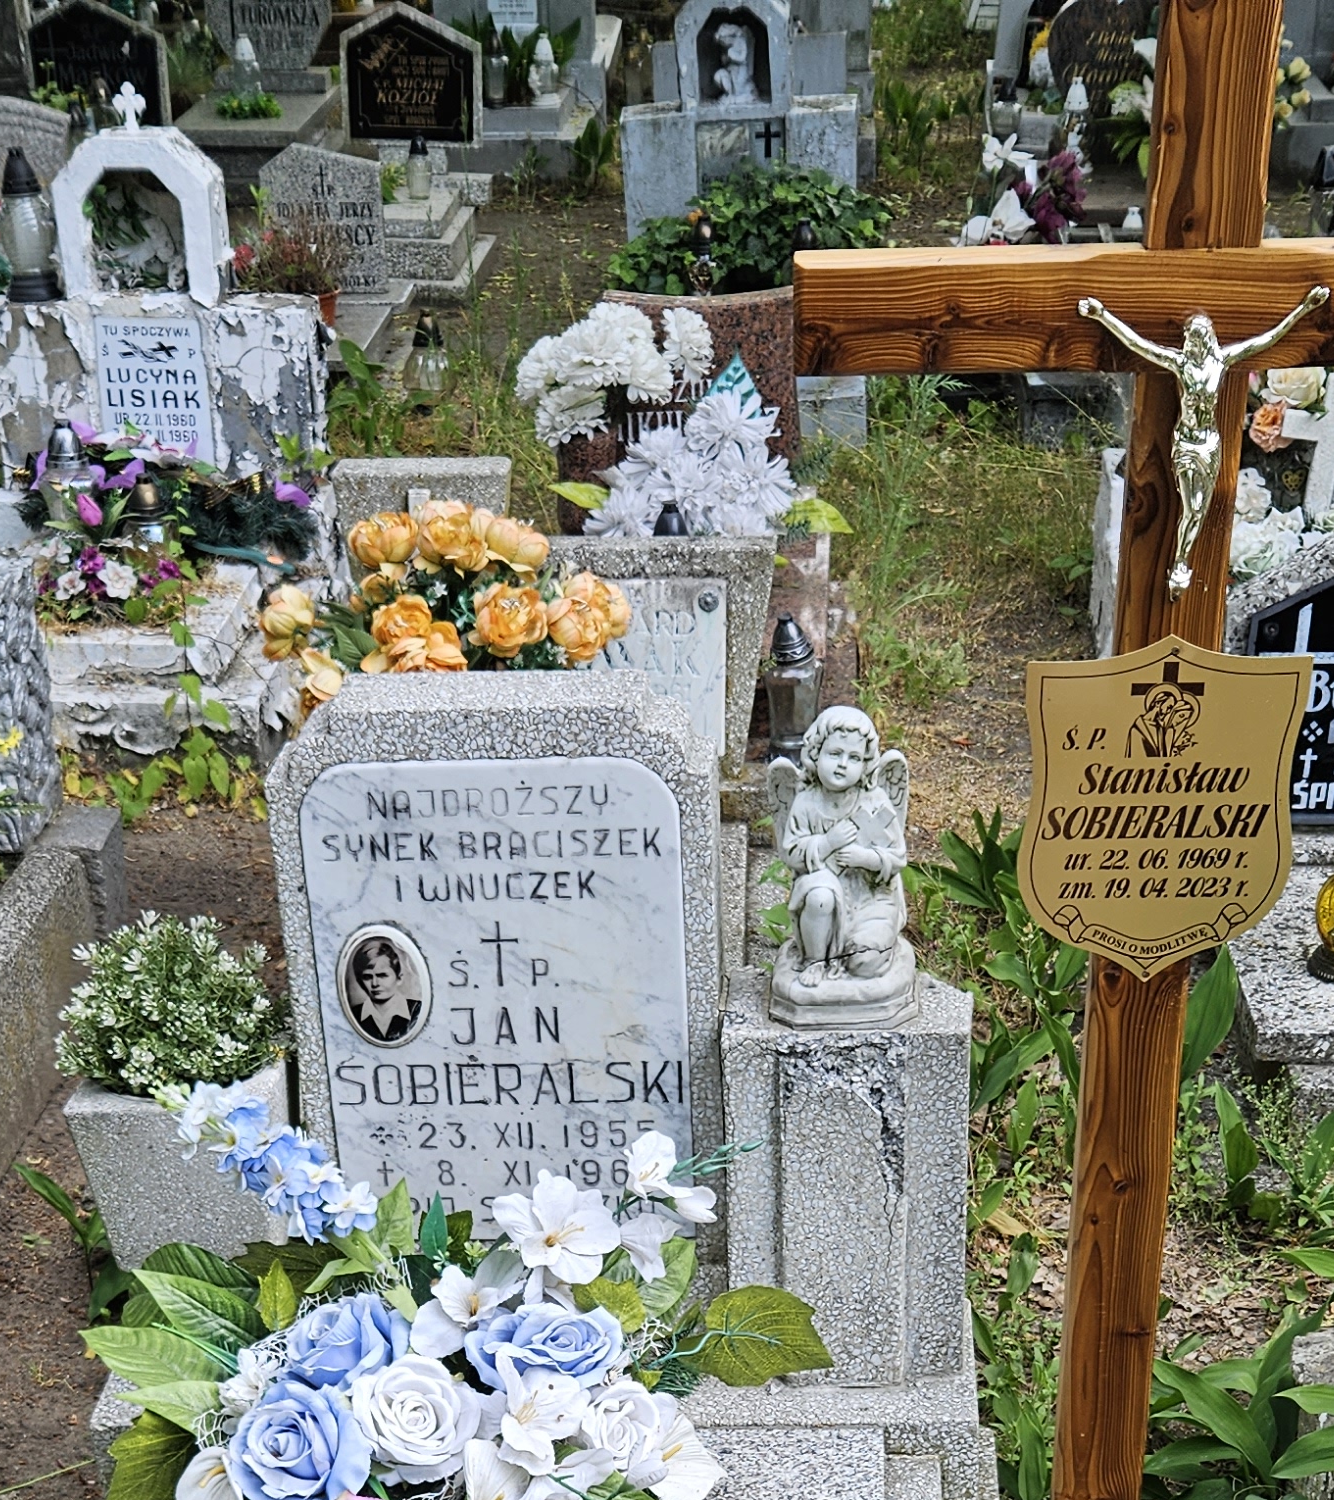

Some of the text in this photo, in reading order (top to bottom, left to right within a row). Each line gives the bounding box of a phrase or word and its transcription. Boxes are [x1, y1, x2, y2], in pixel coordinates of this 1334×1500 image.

[102, 325, 191, 337] TU SPOCZYWA
[187, 348, 196, 359] P
[106, 367, 197, 385] LUCYNA
[106, 388, 201, 409] LISIAK
[1062, 724, 1106, 751] Ś. P.
[1079, 762, 1250, 795] Stanisław
[366, 781, 610, 821] NAJDROŻSZY
[1041, 804, 1271, 840] SOBIERALSKI
[321, 827, 662, 862] SYNEK BRACISZEK
[1064, 848, 1249, 871] ur. 22. 06. 1969 r.
[395, 870, 596, 902] I WNUCZEK
[1058, 877, 1249, 900] zm. 19. 04. 2023 r.
[1092, 927, 1209, 955] PROSI O MODLITWĘ
[531, 958, 560, 988] P.
[450, 1006, 560, 1046] JAN
[335, 1060, 684, 1106] SOBIERALSKI
[417, 1121, 476, 1150] 23.
[493, 1121, 546, 1149] XII.
[438, 1159, 467, 1186] 8.
[565, 1158, 629, 1186] 196
